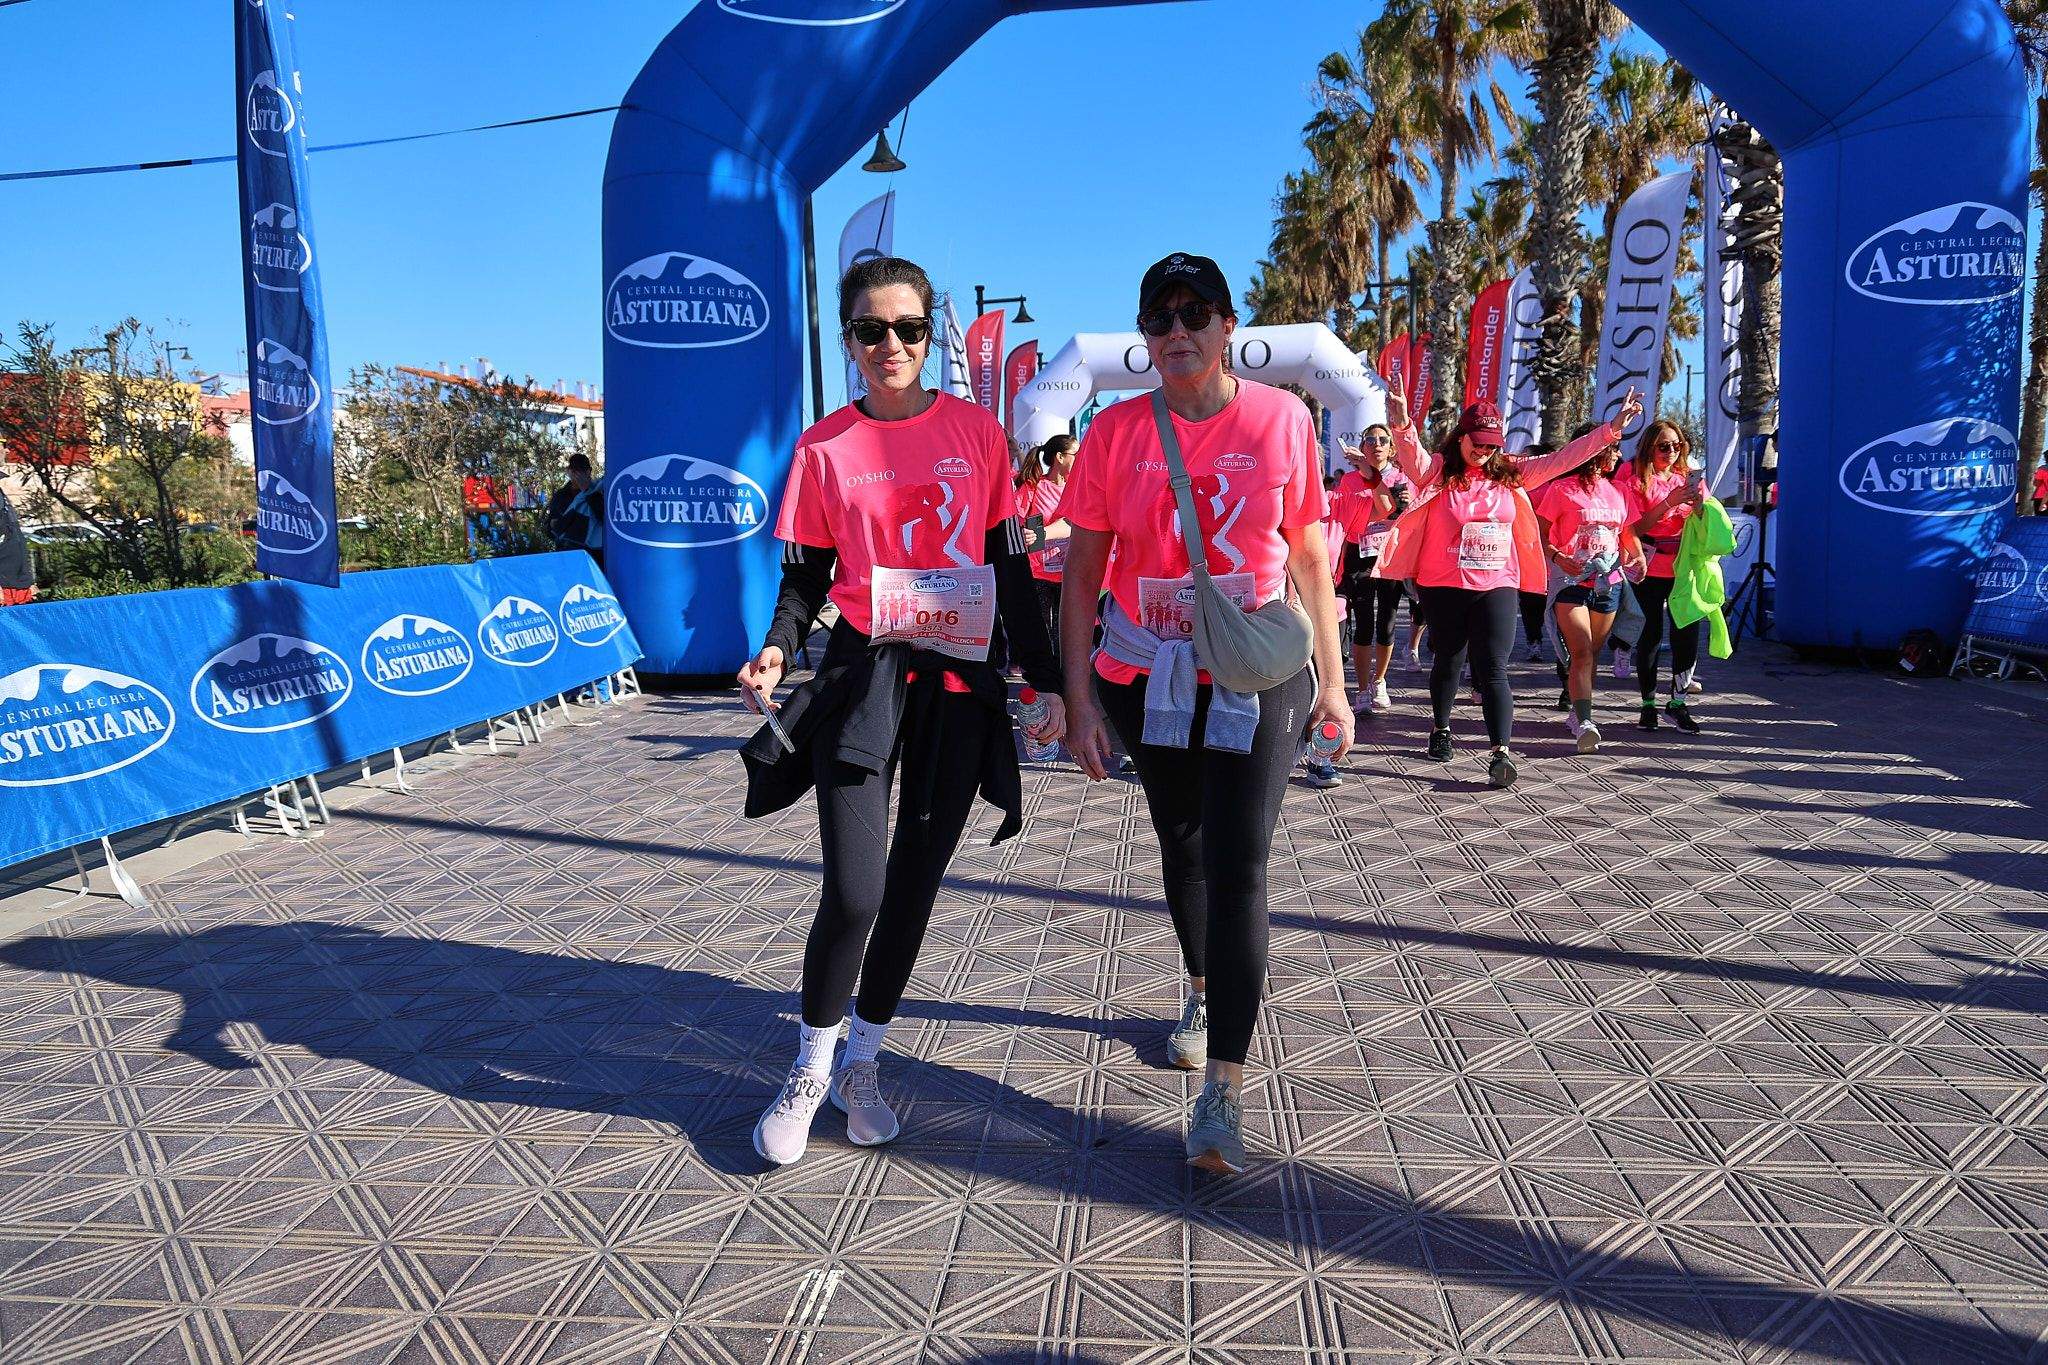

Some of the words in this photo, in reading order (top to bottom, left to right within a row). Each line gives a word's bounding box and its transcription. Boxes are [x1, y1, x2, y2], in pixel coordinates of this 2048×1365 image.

[1901, 237, 1975, 252] CENTRAL
[627, 285, 682, 296] CENTRAL
[689, 285, 751, 299] LECHERA
[611, 290, 757, 328] ASTURIANA
[1602, 218, 1670, 441] OYSHO
[1476, 305, 1500, 398] Santander
[978, 335, 993, 412] antander
[1315, 368, 1360, 380] OYSHO
[1037, 381, 1080, 391] OYSHO
[1410, 349, 1431, 419] Santander
[1136, 460, 1168, 472] OYSH
[1894, 451, 1966, 463] CENTRAL
[846, 470, 895, 488] OYSHO
[1855, 457, 2015, 492] ASTURIANA
[628, 486, 683, 496] CENTRAL
[690, 486, 751, 498] LECHERA
[613, 488, 757, 525] ASTURIANA
[257, 507, 316, 541] TURIANA
[1480, 543, 1498, 552] 016
[1592, 543, 1607, 551] 016
[913, 581, 955, 590] ASTURIANA
[915, 610, 959, 625] 016
[384, 641, 421, 655] CENTRAL
[421, 634, 457, 651] LECHERA
[488, 624, 556, 656] ASTURIANA
[940, 643, 975, 656] Santander
[950, 637, 975, 645] VALENCIA
[227, 665, 281, 685] CENTRAL
[285, 656, 331, 673] LECHERA
[372, 645, 469, 683] ASTURIANA
[76, 691, 145, 711] LECHERA
[210, 669, 346, 719] ASTURIANA
[0, 706, 166, 764] STURIANA
